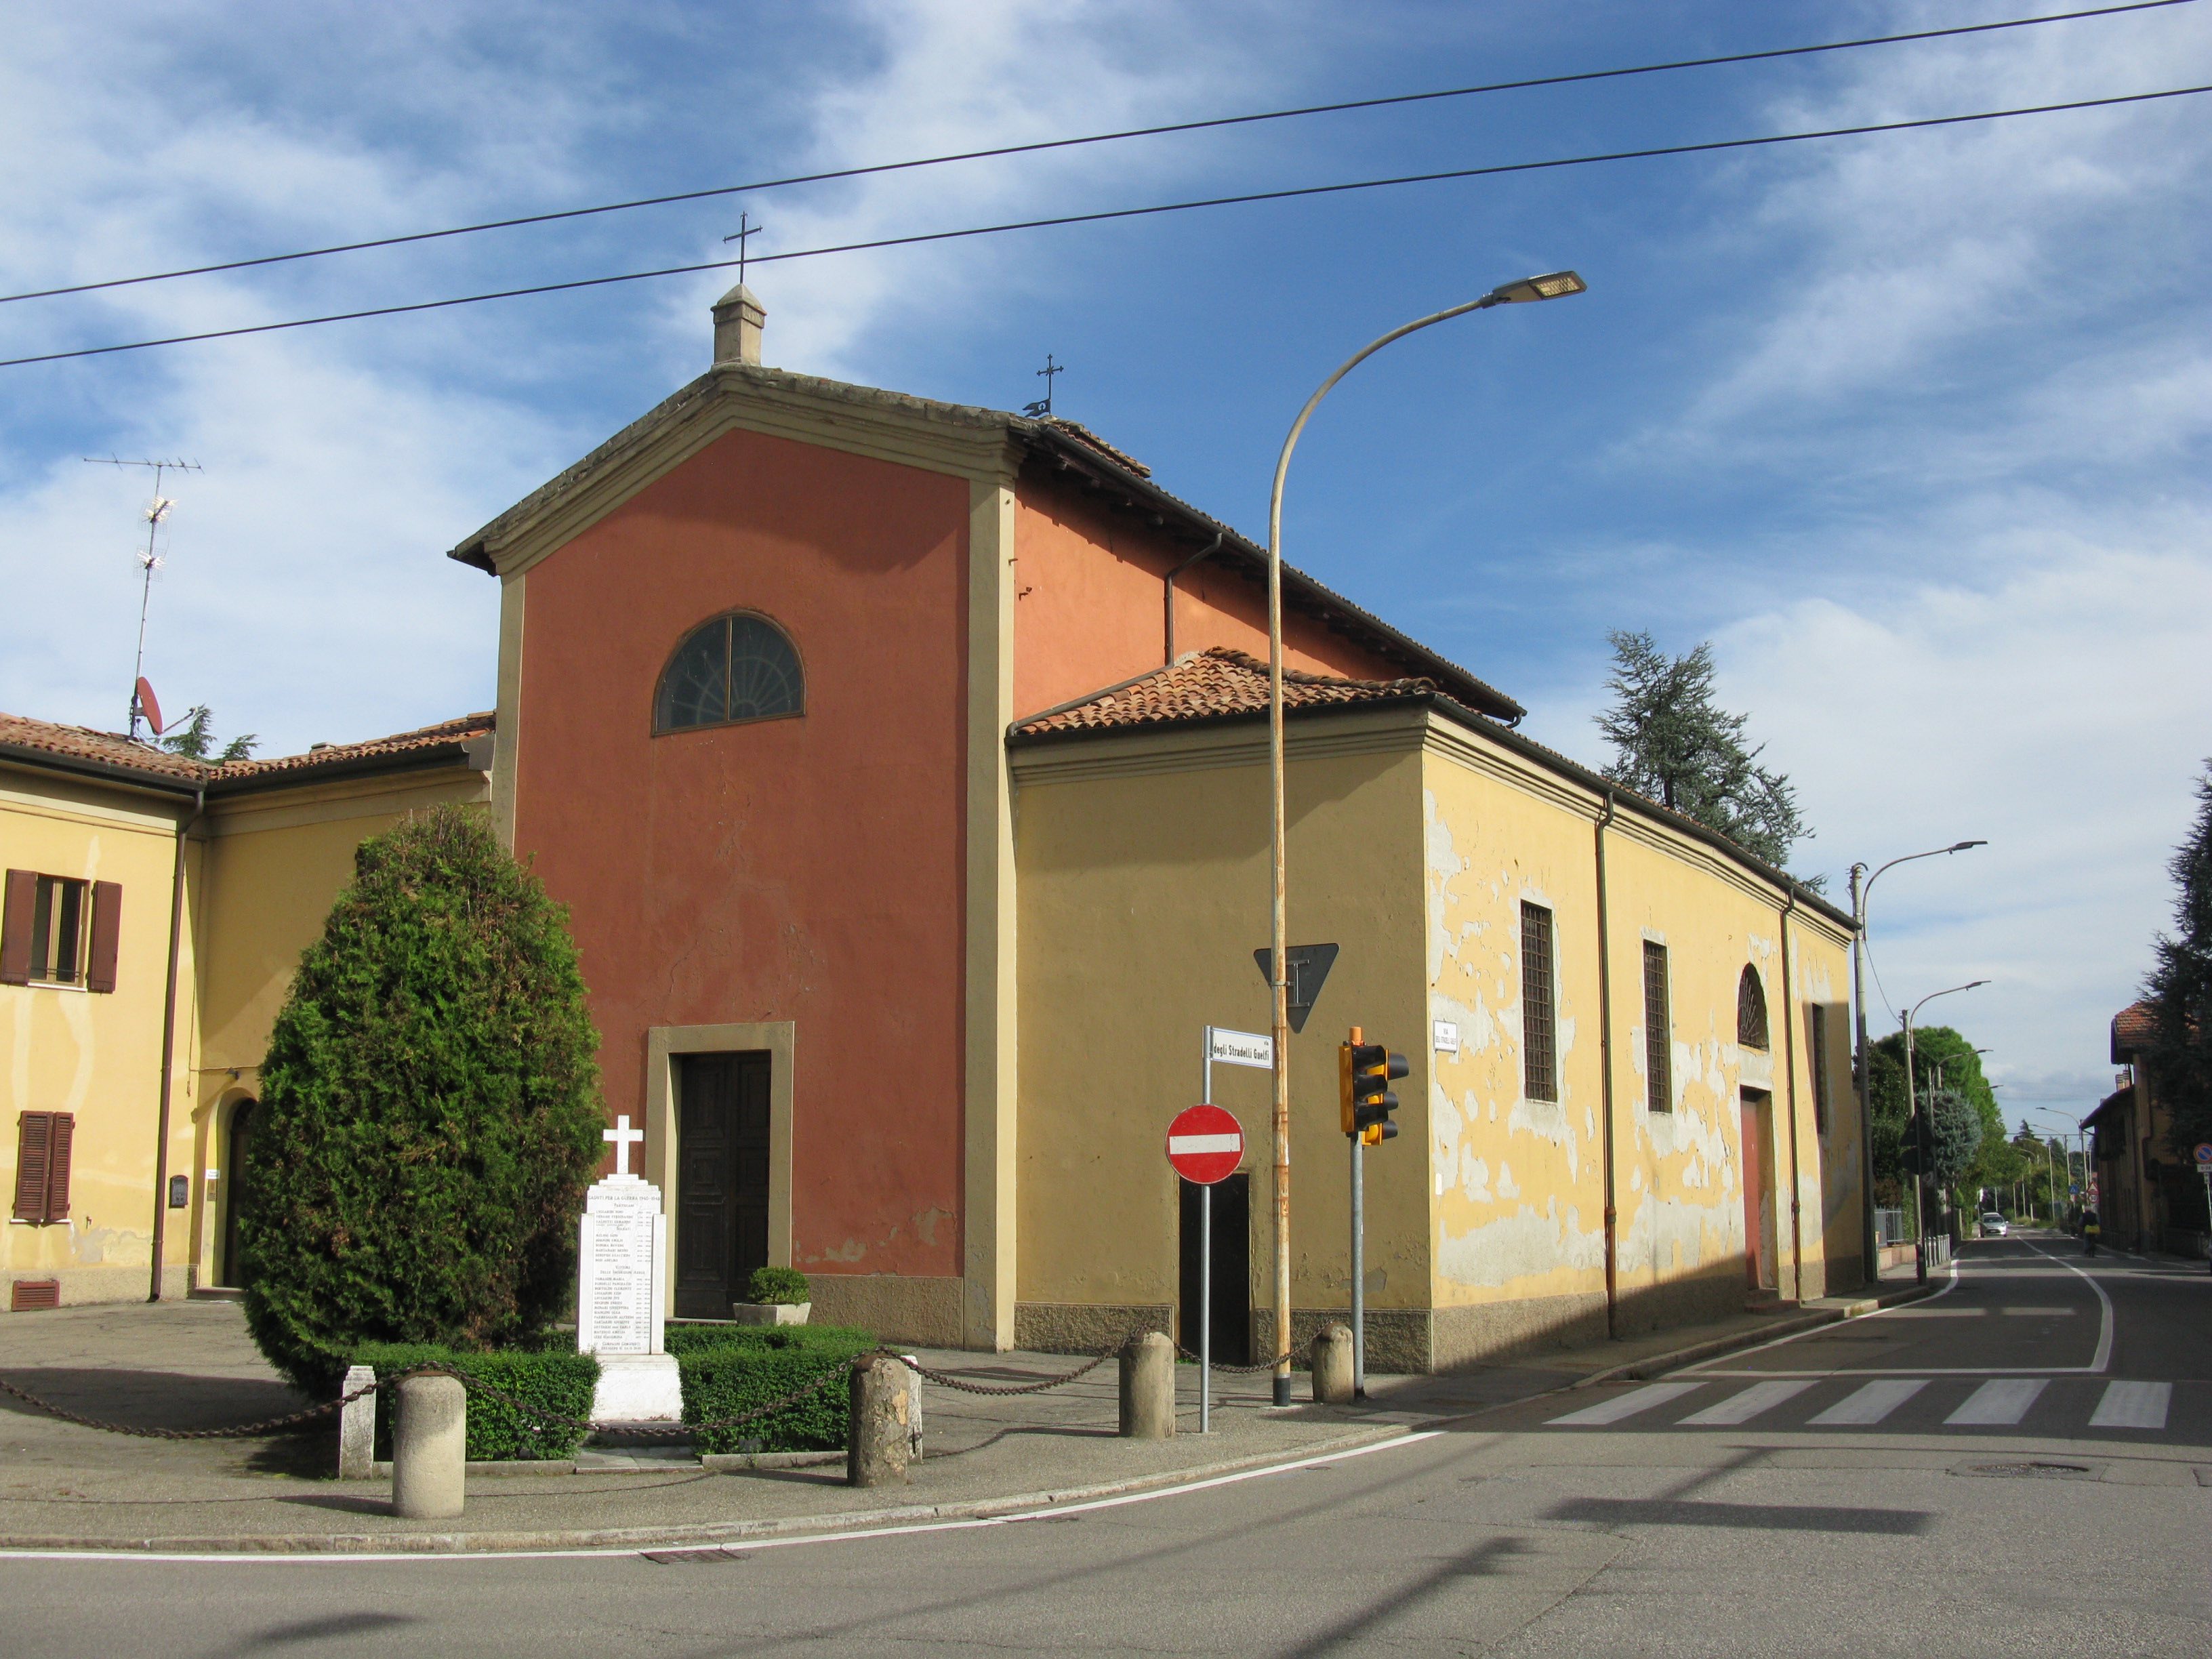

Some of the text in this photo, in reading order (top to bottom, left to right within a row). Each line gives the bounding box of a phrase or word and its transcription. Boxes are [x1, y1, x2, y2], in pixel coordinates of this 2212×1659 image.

[1214, 1043, 1269, 1061] degli Stradelli Guelfi
